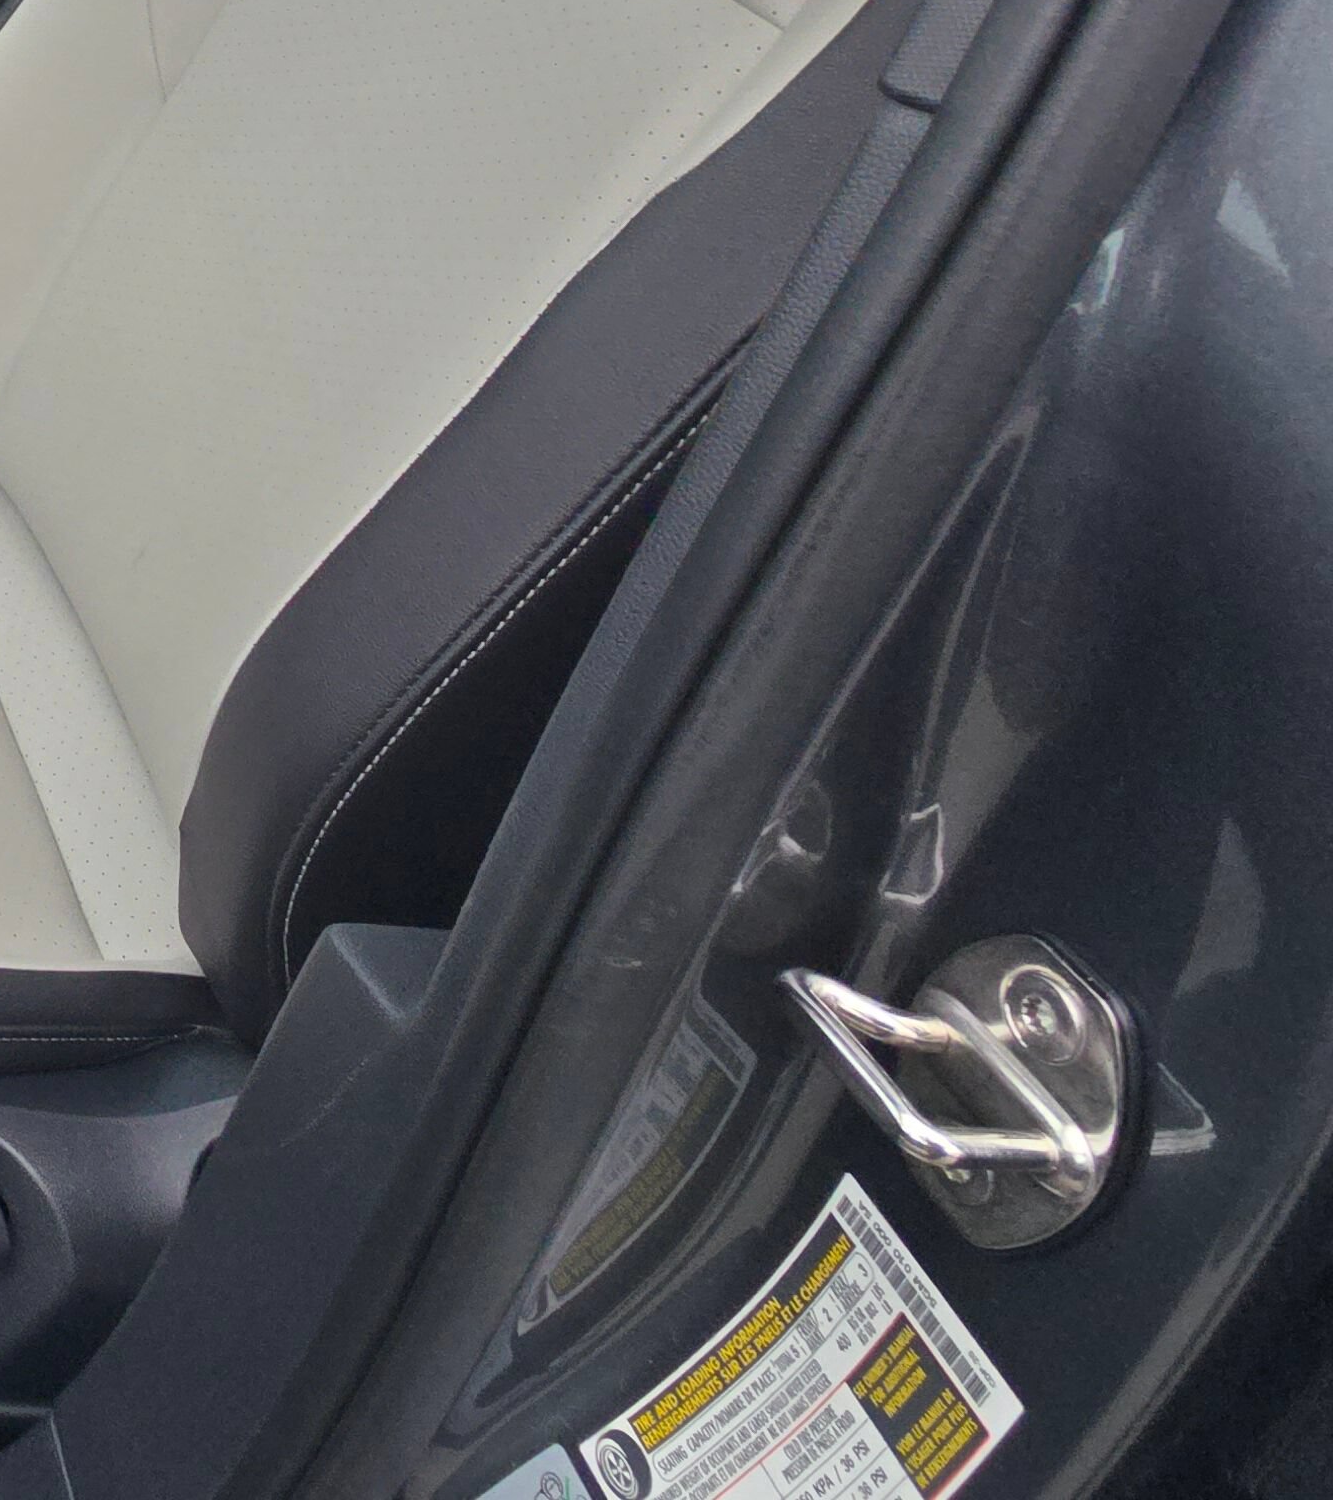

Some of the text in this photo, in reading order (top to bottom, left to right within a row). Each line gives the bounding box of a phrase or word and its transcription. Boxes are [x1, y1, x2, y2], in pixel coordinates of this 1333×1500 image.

[872, 1220, 893, 1247] 000
[856, 1262, 869, 1278] 3
[891, 1247, 913, 1274] 010
[820, 1306, 834, 1322] 2
[632, 1295, 781, 1434] TIRE AND LOADING INFORMATION
[640, 1232, 852, 1449] RENSEIGNEMENTS SUR LES PNEUS ET LE CHARGEMENT
[834, 1331, 853, 1353] 400
[882, 1365, 928, 1418] INFORMATION
[656, 1443, 689, 1474] SEATING
[741, 1385, 756, 1404] DE
[749, 1366, 777, 1396] PLACES
[698, 1458, 711, 1475] OF
[705, 1434, 741, 1469] OCCUPANTS
[734, 1424, 752, 1444] AND
[746, 1408, 770, 1435] CARGO
[895, 1430, 917, 1456] VOIR
[910, 1422, 925, 1440] LE
[940, 1387, 956, 1405] DE
[931, 1417, 954, 1444] POUR
[947, 1400, 968, 1426] PLUS
[811, 1472, 835, 1498] KPA
[832, 1465, 842, 1484] /
[838, 1453, 856, 1474] 36
[850, 1437, 871, 1461] PSI
[868, 1465, 889, 1488] PSI
